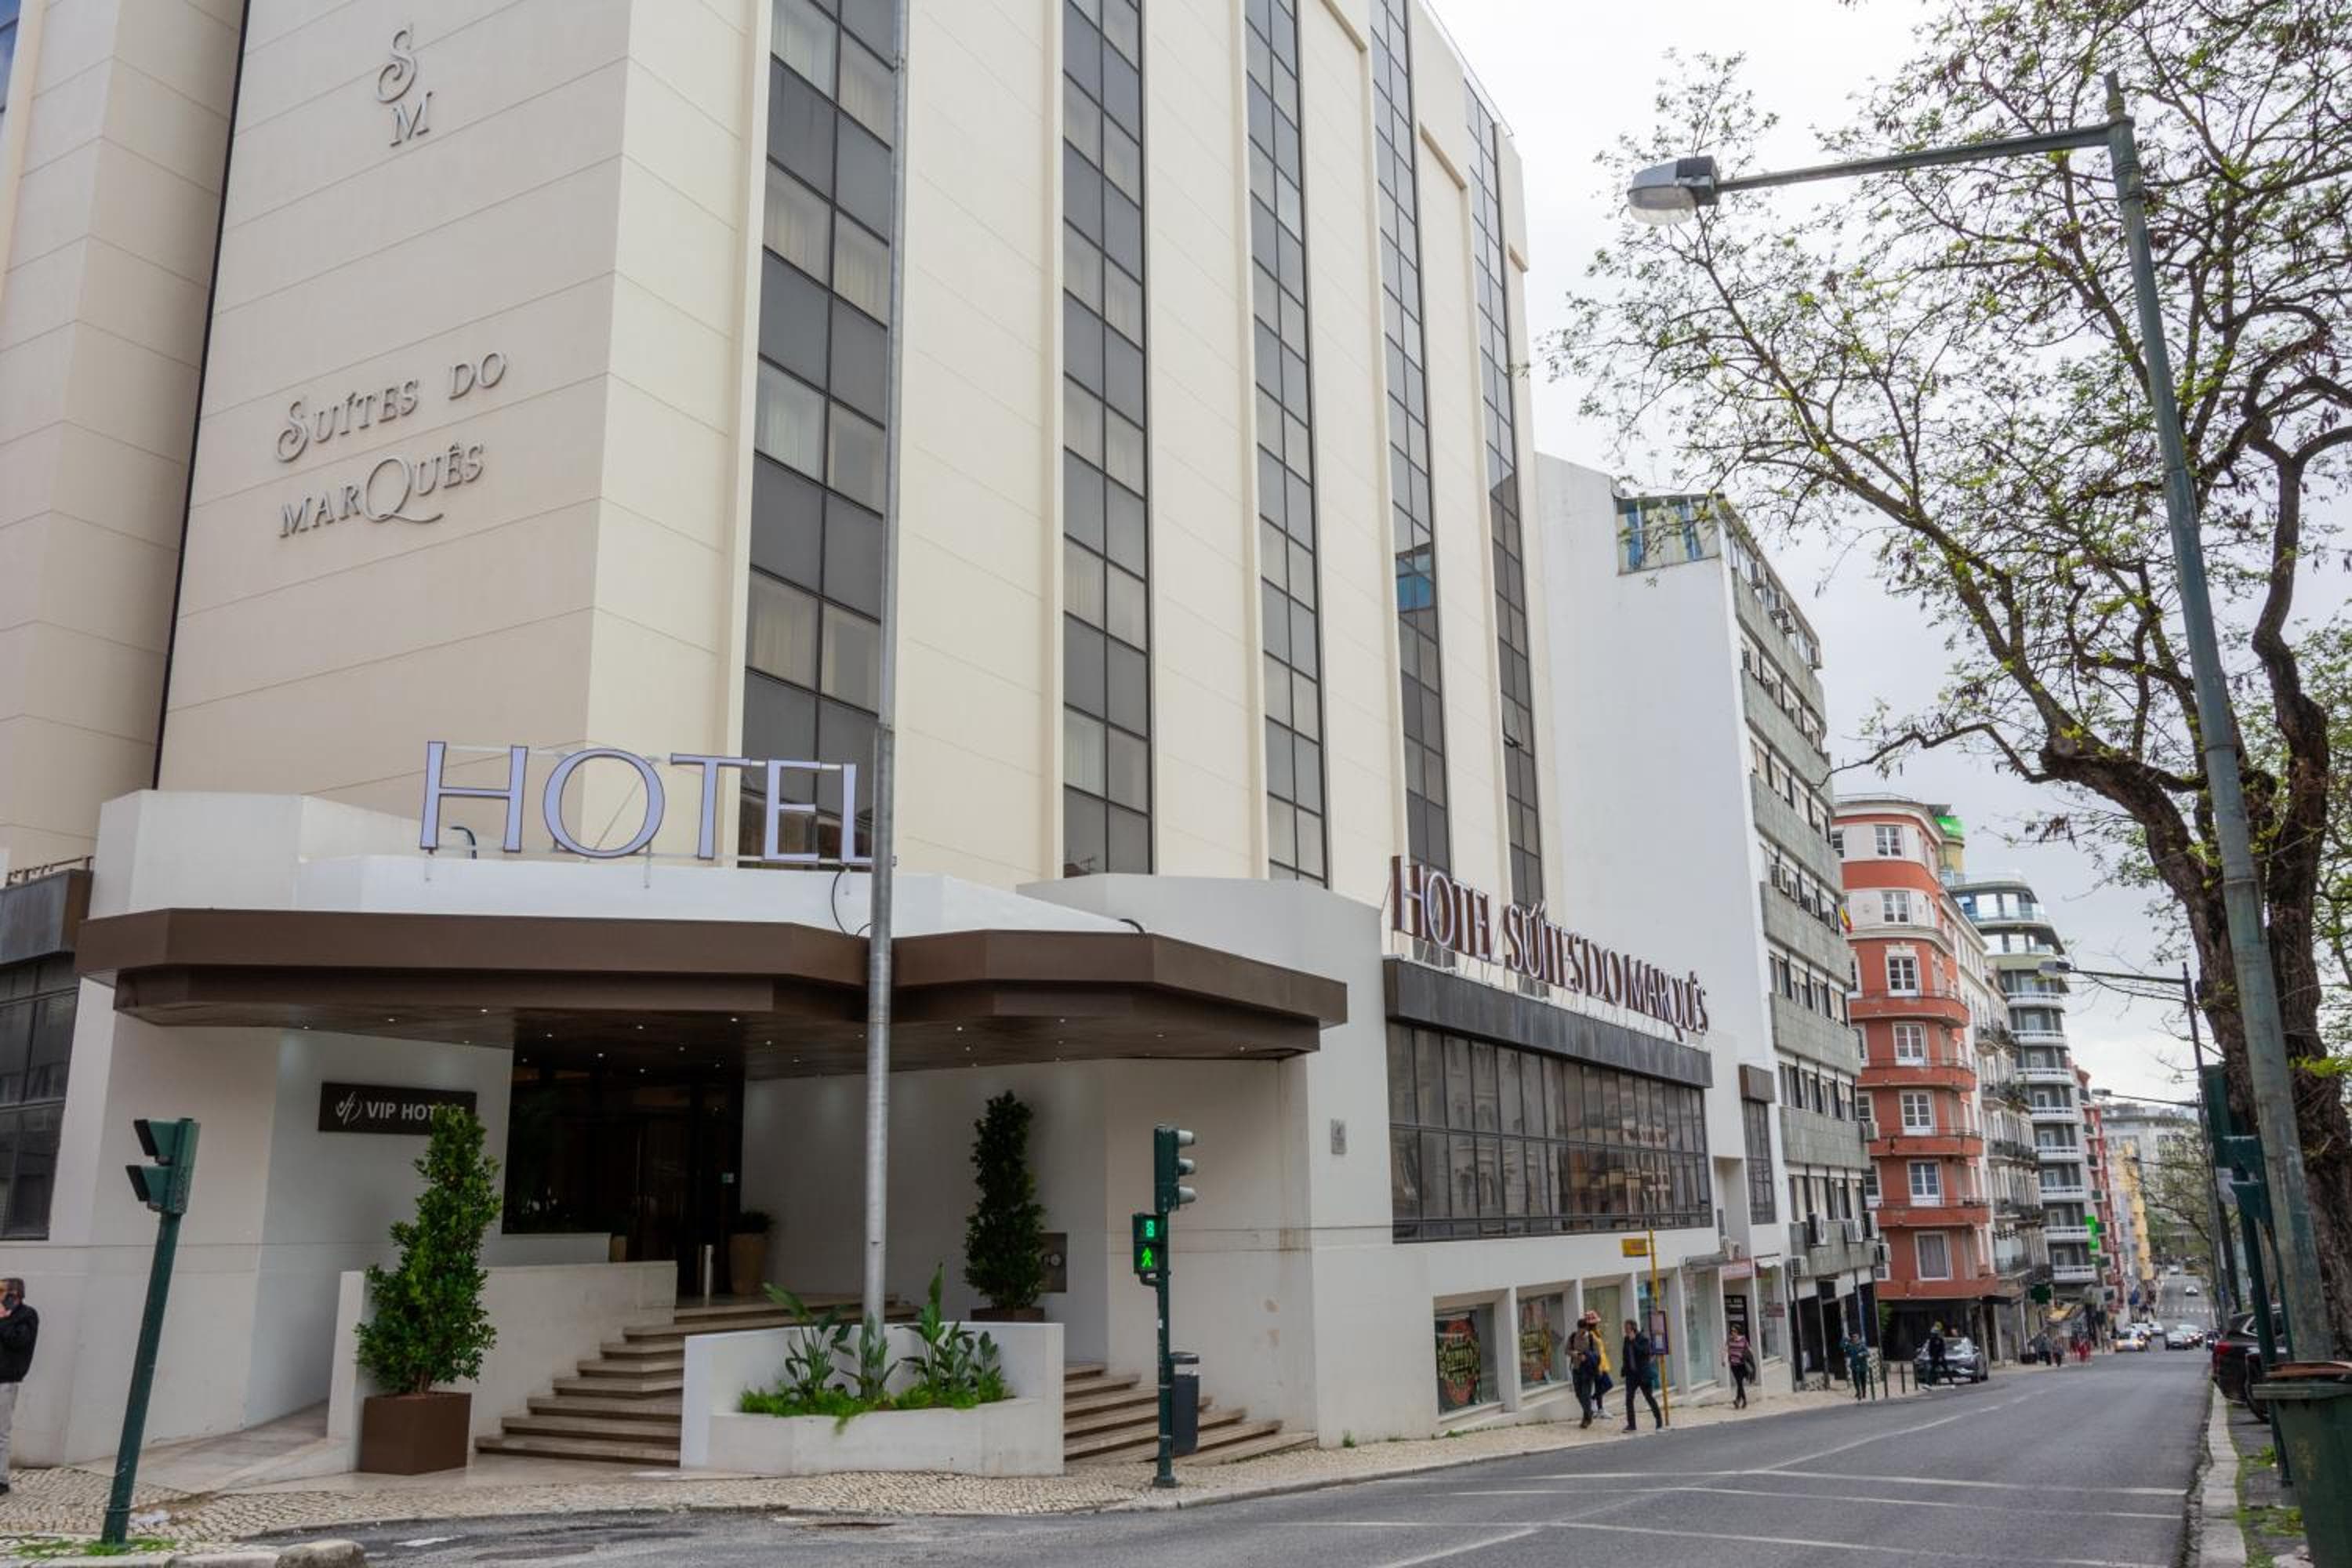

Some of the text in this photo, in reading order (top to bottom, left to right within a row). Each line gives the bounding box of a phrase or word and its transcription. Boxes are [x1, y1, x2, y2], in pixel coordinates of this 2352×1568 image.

[375, 23, 416, 104] S
[389, 91, 434, 147] M
[448, 350, 507, 401] DO
[419, 741, 873, 863] HOTEL
[1391, 855, 1502, 965] HOTEL
[1583, 938, 1622, 1007] DO
[366, 1101, 396, 1119] VIP
